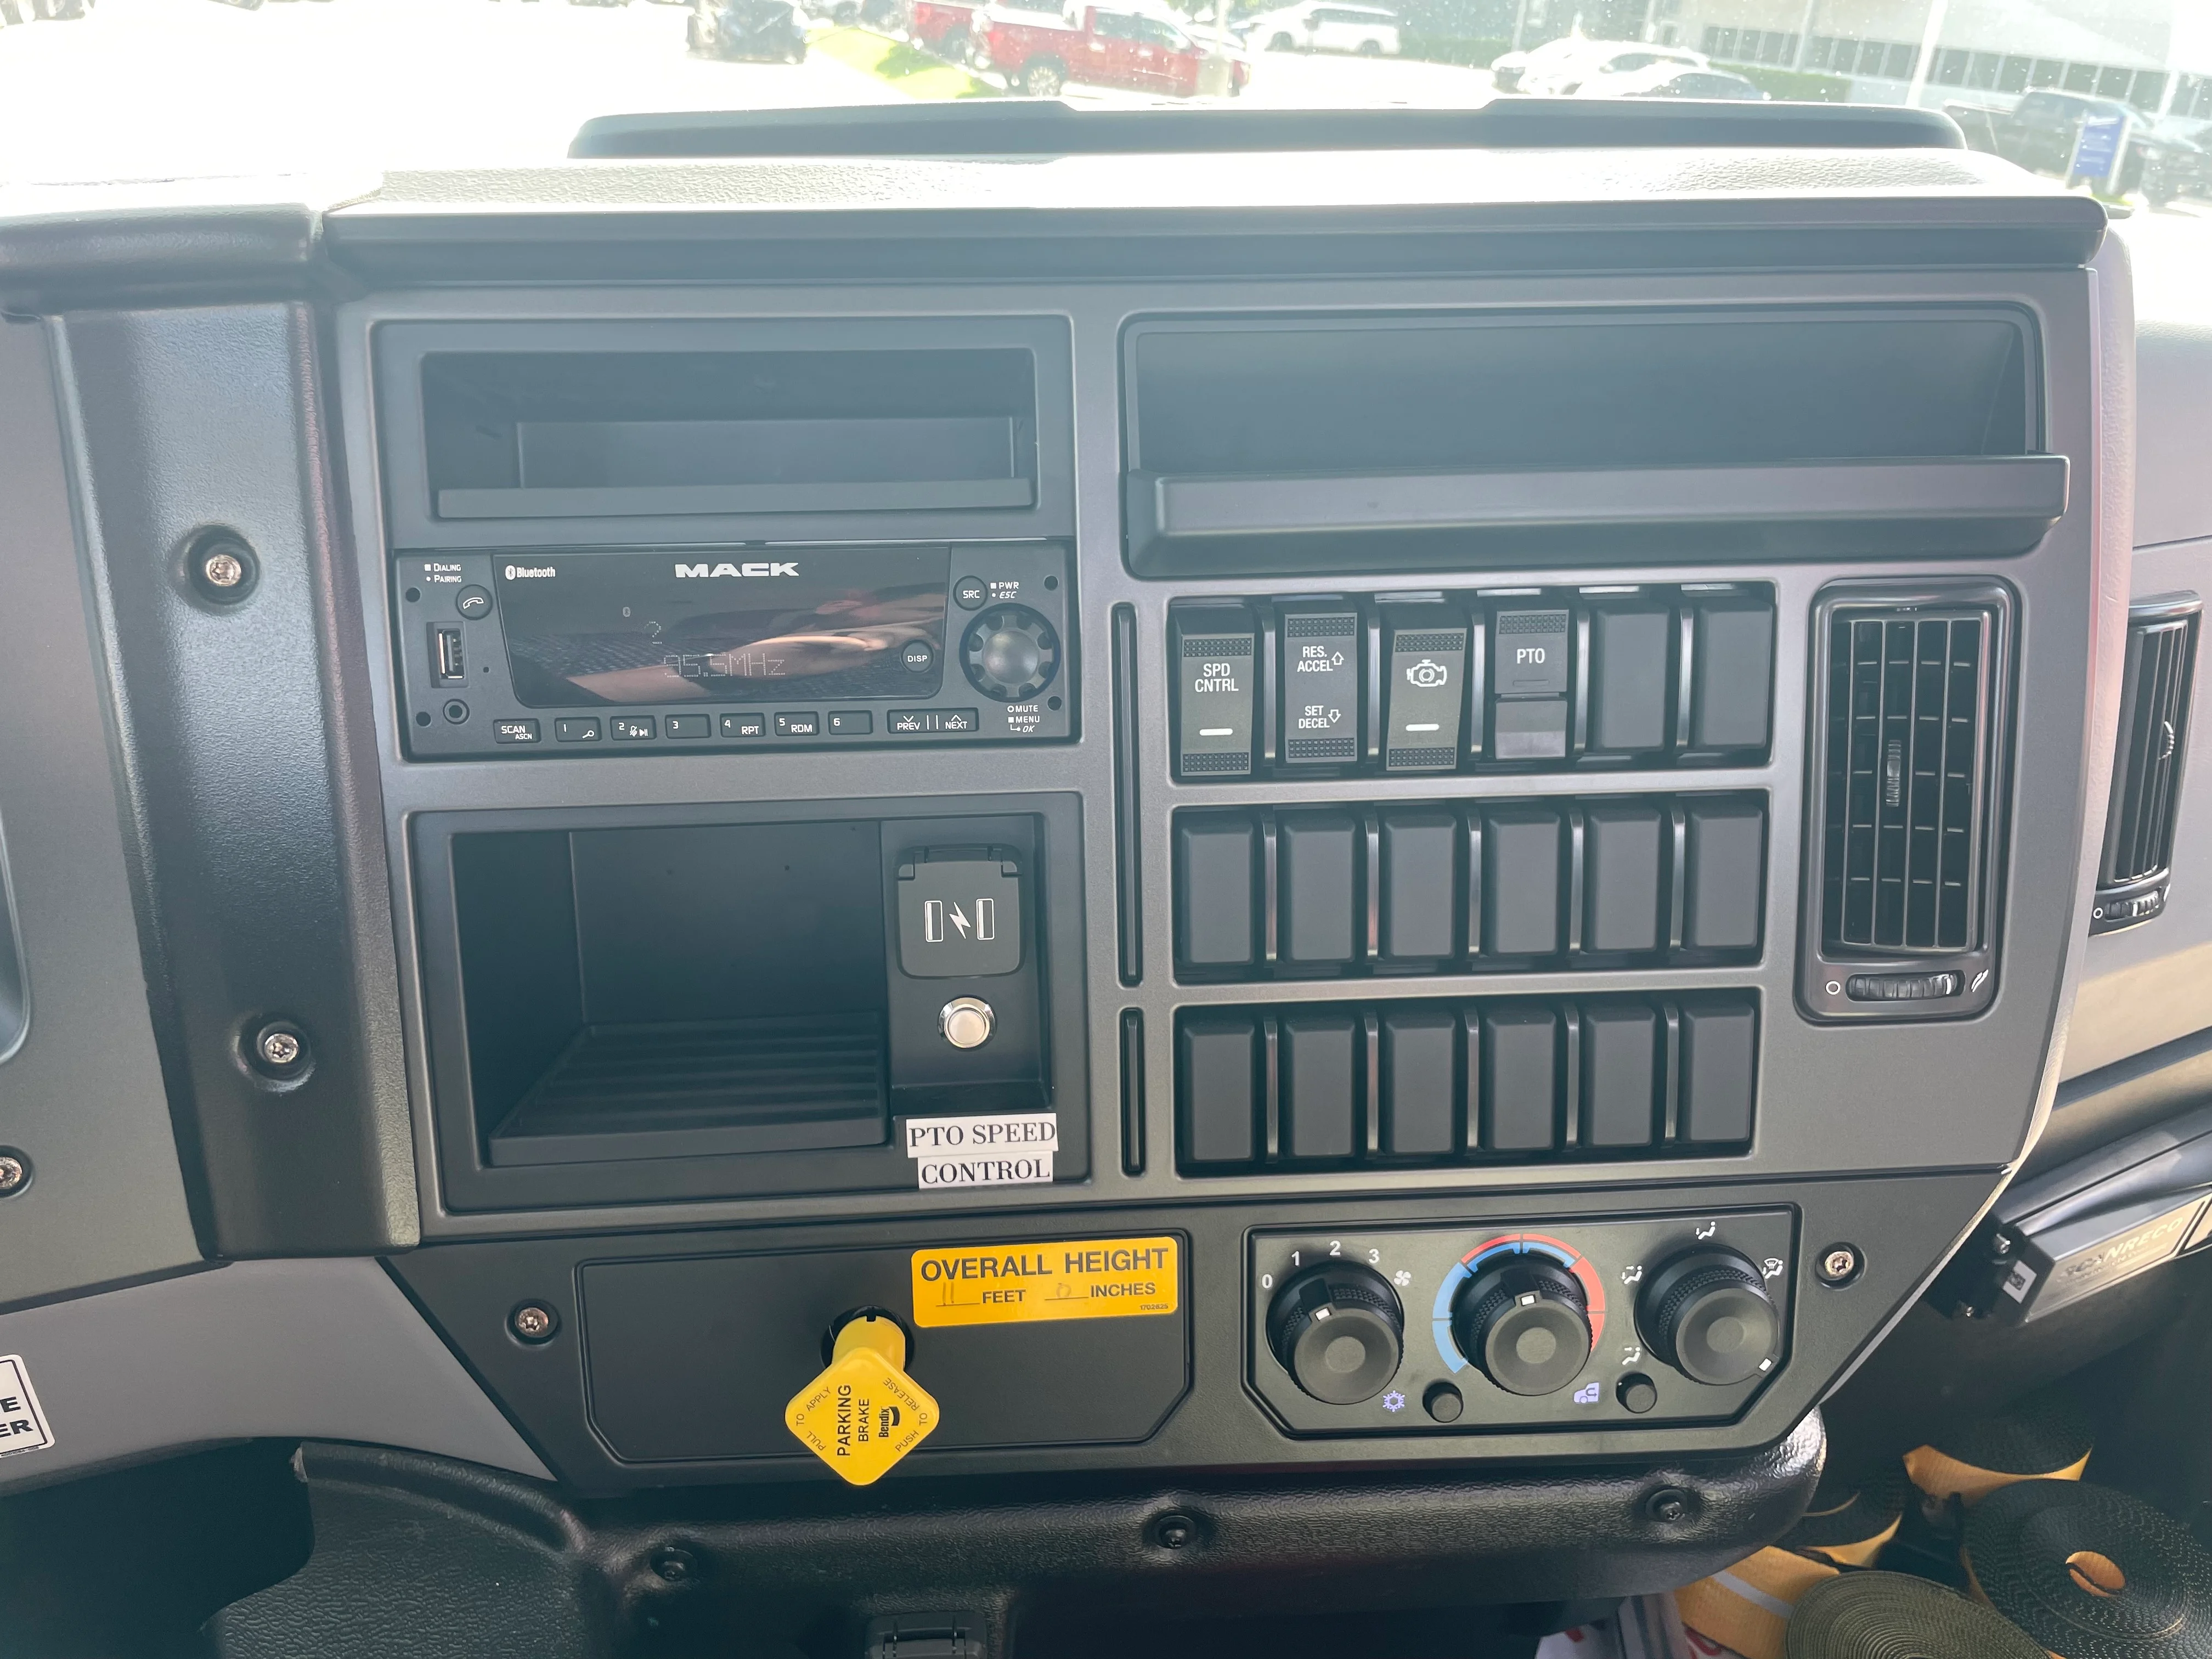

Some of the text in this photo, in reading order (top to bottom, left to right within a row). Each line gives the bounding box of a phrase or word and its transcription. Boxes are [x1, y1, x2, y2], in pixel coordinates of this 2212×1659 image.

[433, 563, 461, 572] DIALING
[516, 566, 556, 578] Bluetooth
[674, 563, 799, 578] MACK
[434, 574, 462, 584] PAIRING
[998, 582, 1019, 590] PWR
[962, 590, 980, 599] SRC
[998, 591, 1017, 599] ESC
[907, 654, 928, 663] DISP
[1302, 646, 1327, 659] RES.
[1516, 648, 1545, 664] PTO
[1203, 663, 1231, 678] SPD
[1297, 659, 1333, 673] ACCEL
[1195, 677, 1239, 693] CNTRL
[1015, 705, 1039, 713] MUTE
[1305, 705, 1323, 717] SET
[672, 720, 679, 729] 3
[724, 719, 731, 729] 4
[779, 718, 786, 727] 5
[833, 718, 840, 727] 6
[945, 720, 968, 730] NEXT
[1015, 715, 1040, 724] MENU
[1298, 717, 1330, 729] DECEL
[501, 724, 526, 735] SCAN
[563, 724, 567, 733] 1
[618, 722, 625, 731] 2
[741, 725, 760, 735] RPT
[791, 724, 812, 733] RDM
[896, 721, 921, 731] PREV
[1022, 725, 1035, 733] OK
[909, 1121, 1056, 1148] PTO SPEED
[922, 1159, 1050, 1184] CONTROL
[1329, 1240, 1341, 1256] 2
[1291, 1251, 1300, 1266] 1
[1368, 1249, 1380, 1263] 3
[921, 1247, 1169, 1282] OVERALL HEIGHT
[1261, 1274, 1273, 1289] 0
[982, 1288, 1026, 1304] FEET
[1091, 1282, 1156, 1299] INCHES
[797, 1386, 831, 1451] PULL TO APPLY
[837, 1384, 851, 1456] PARKING
[859, 1398, 870, 1442] BRAKE
[883, 1377, 928, 1452] PUSH TO RELEASE
[878, 1408, 889, 1437] Bendix
